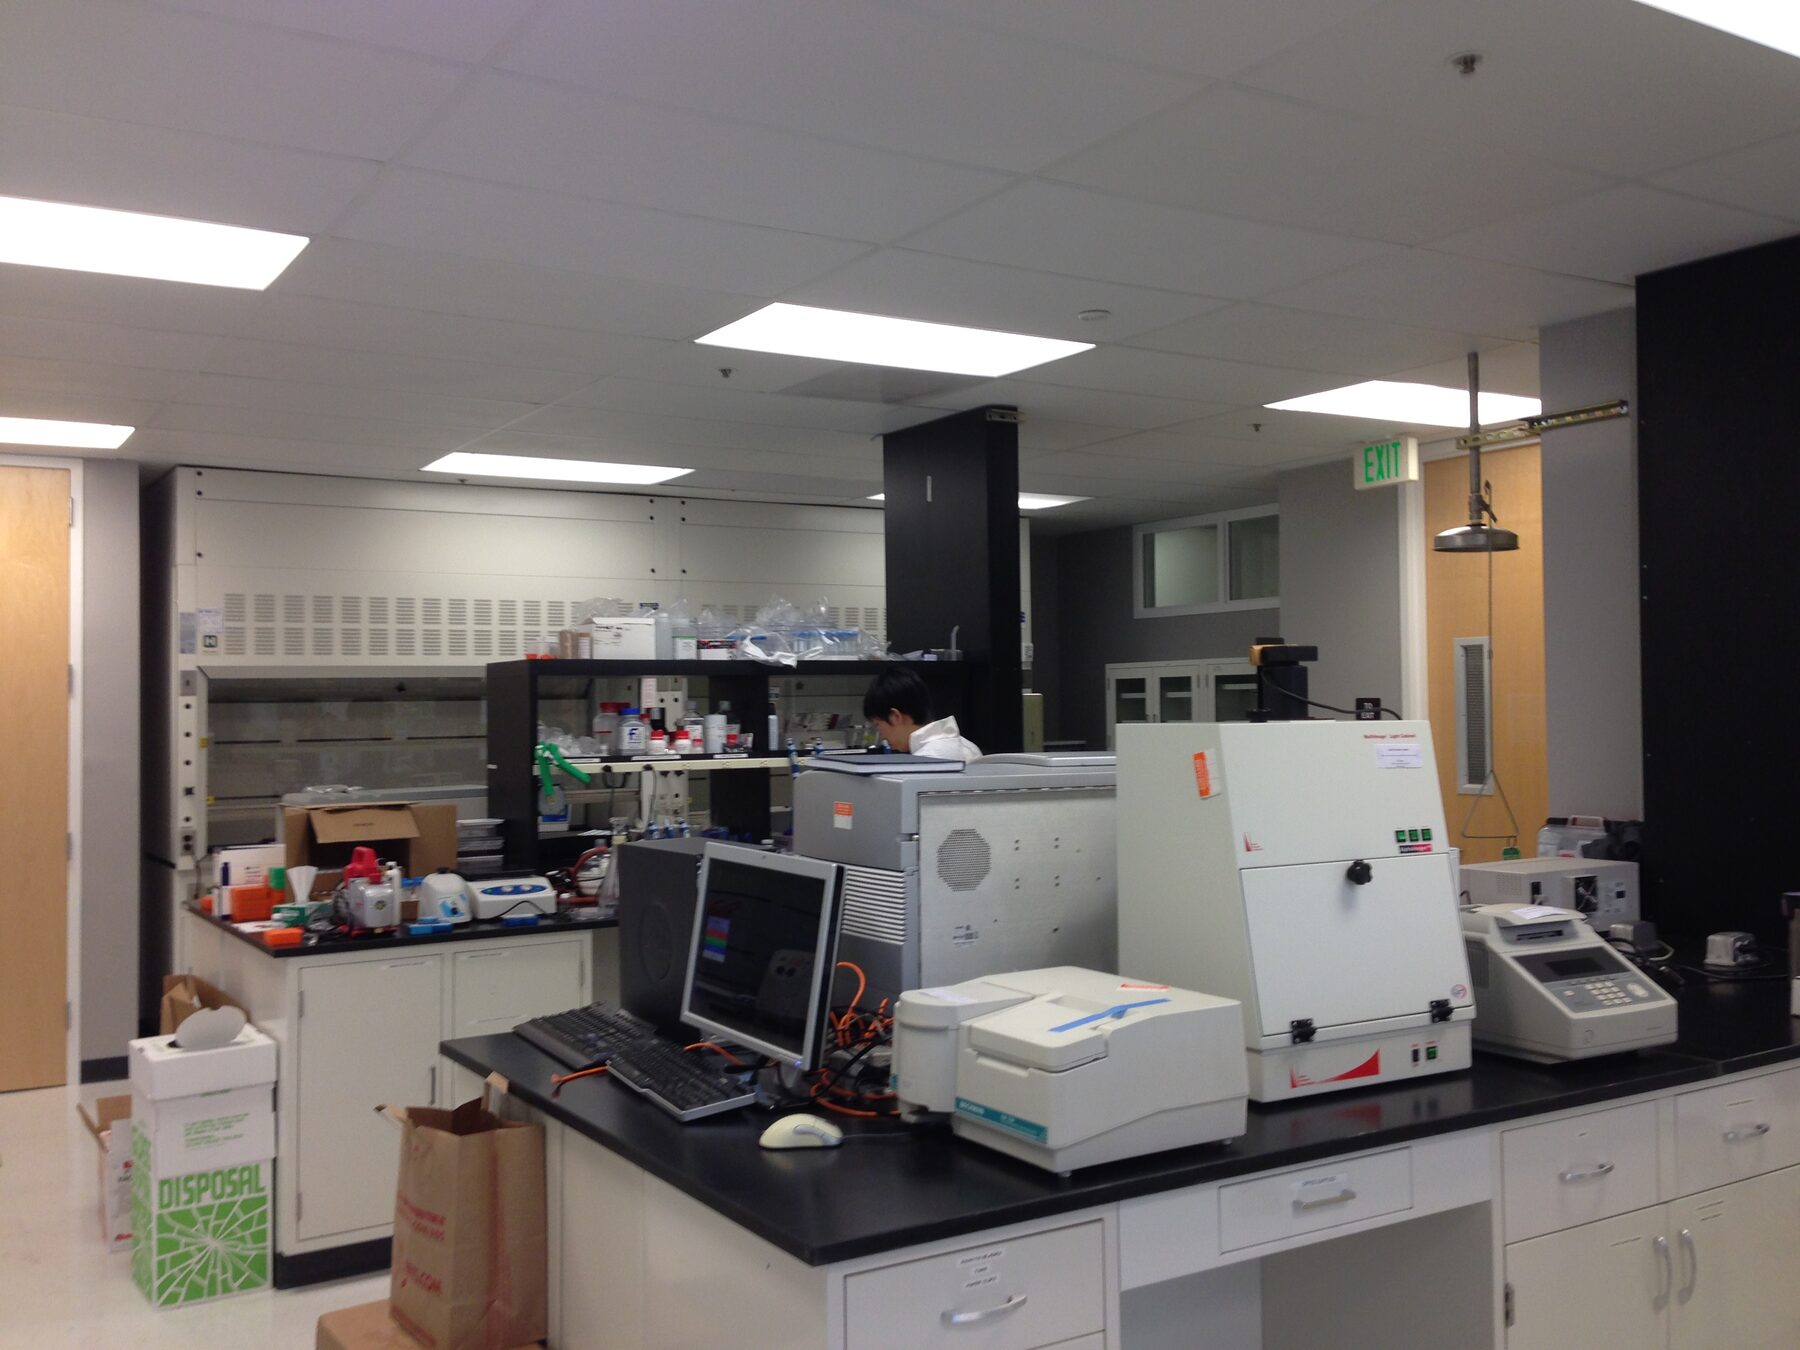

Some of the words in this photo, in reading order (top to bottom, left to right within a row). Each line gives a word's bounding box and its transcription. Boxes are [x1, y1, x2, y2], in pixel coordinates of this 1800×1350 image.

[1365, 442, 1401, 482] EXIT
[1363, 702, 1374, 710] TO
[159, 1164, 266, 1210] DISPOSAL
